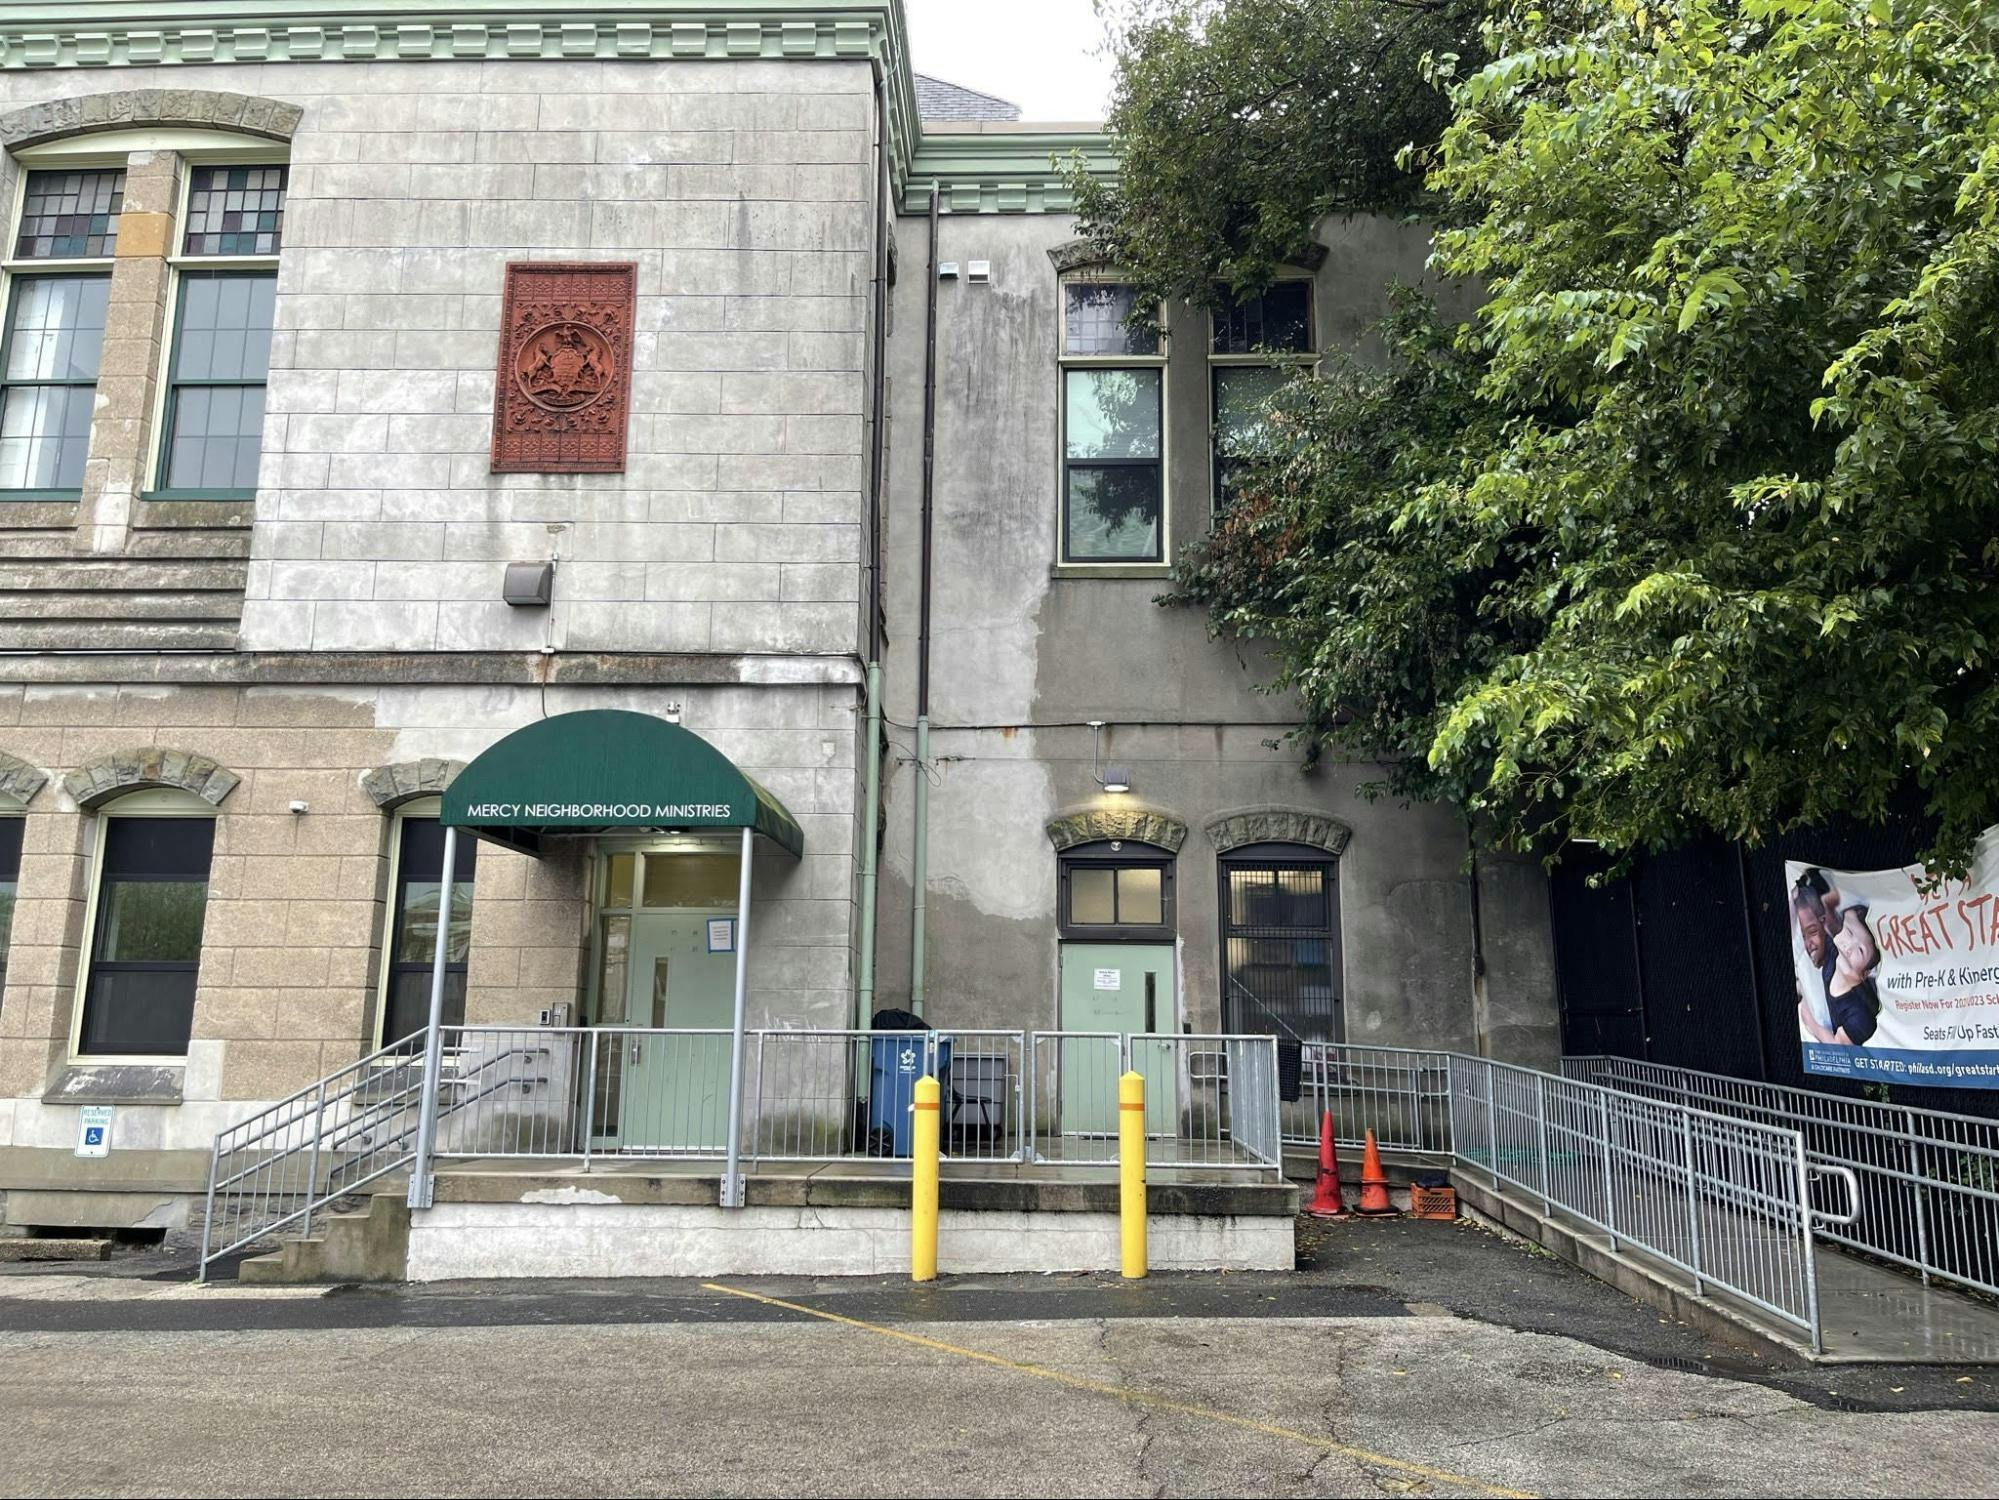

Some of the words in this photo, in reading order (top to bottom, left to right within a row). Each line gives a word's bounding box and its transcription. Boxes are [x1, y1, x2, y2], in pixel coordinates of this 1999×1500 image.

[467, 804, 521, 818] MERCY
[524, 804, 651, 818] NEIGHBORHOOD
[655, 804, 731, 818] MINISTRIES
[1876, 902, 1954, 959] GREAT
[1886, 972, 1912, 989] with
[1915, 969, 1946, 988] Pre-K
[1947, 968, 1957, 986] &
[1895, 999, 1921, 1012] Register
[1921, 1000, 1940, 1010] Now
[1940, 999, 1953, 1009] For
[1923, 1025, 1946, 1040] Seats
[1957, 1024, 1974, 1042] Up
[1854, 1057, 1869, 1069] GET
[1869, 1058, 1908, 1073] STARTED:
[83, 1109, 112, 1117] RESERVED
